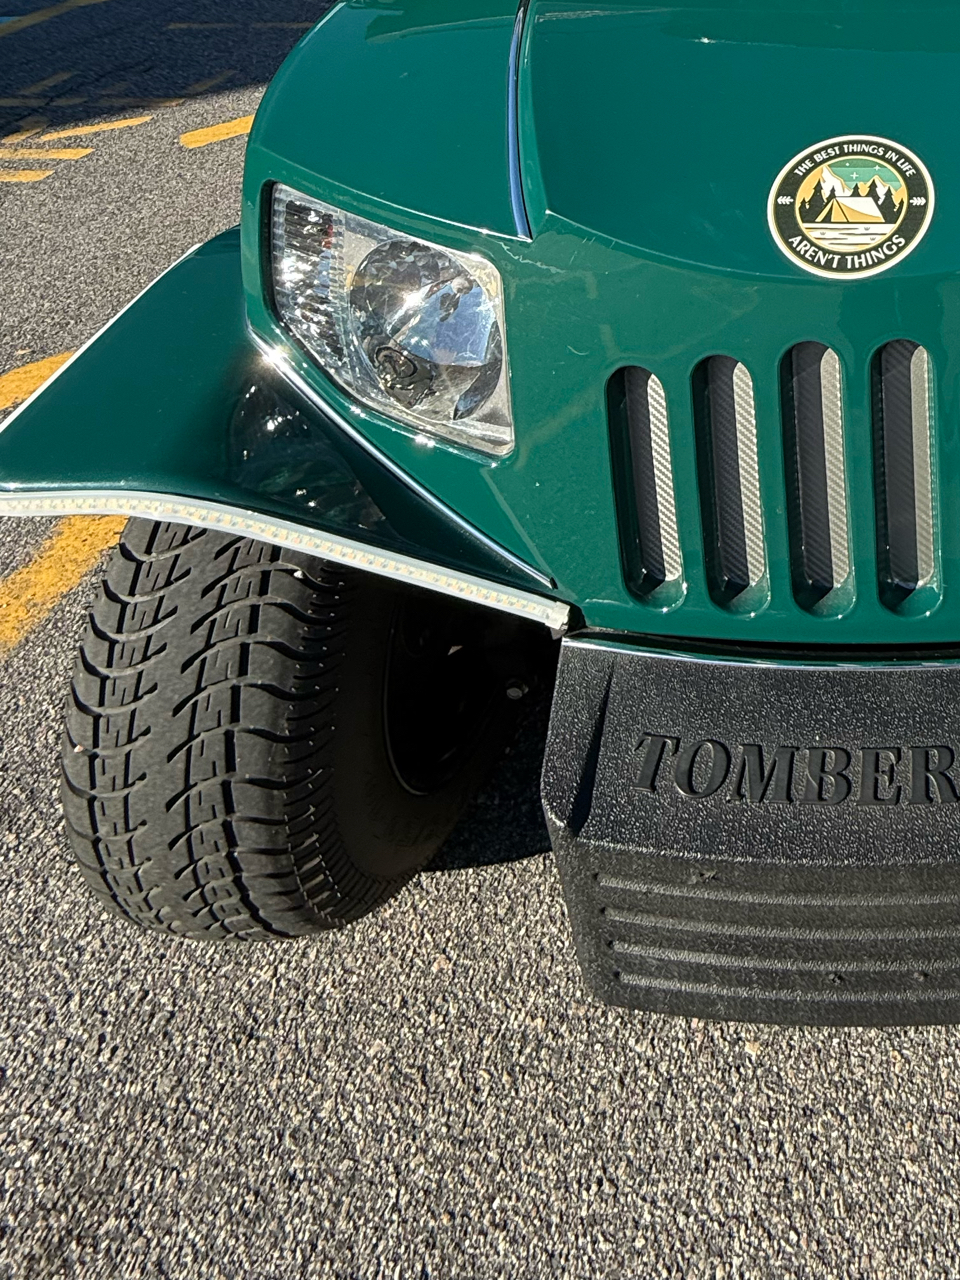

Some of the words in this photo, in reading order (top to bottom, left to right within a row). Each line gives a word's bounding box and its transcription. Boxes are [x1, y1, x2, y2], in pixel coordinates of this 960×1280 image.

[793, 158, 815, 177] THE
[814, 145, 841, 162] BEST
[843, 143, 885, 156] THINGS
[885, 150, 899, 163] IN
[897, 155, 916, 178] LIFE
[788, 235, 841, 269] AREN'T
[845, 234, 906, 269] THINGS
